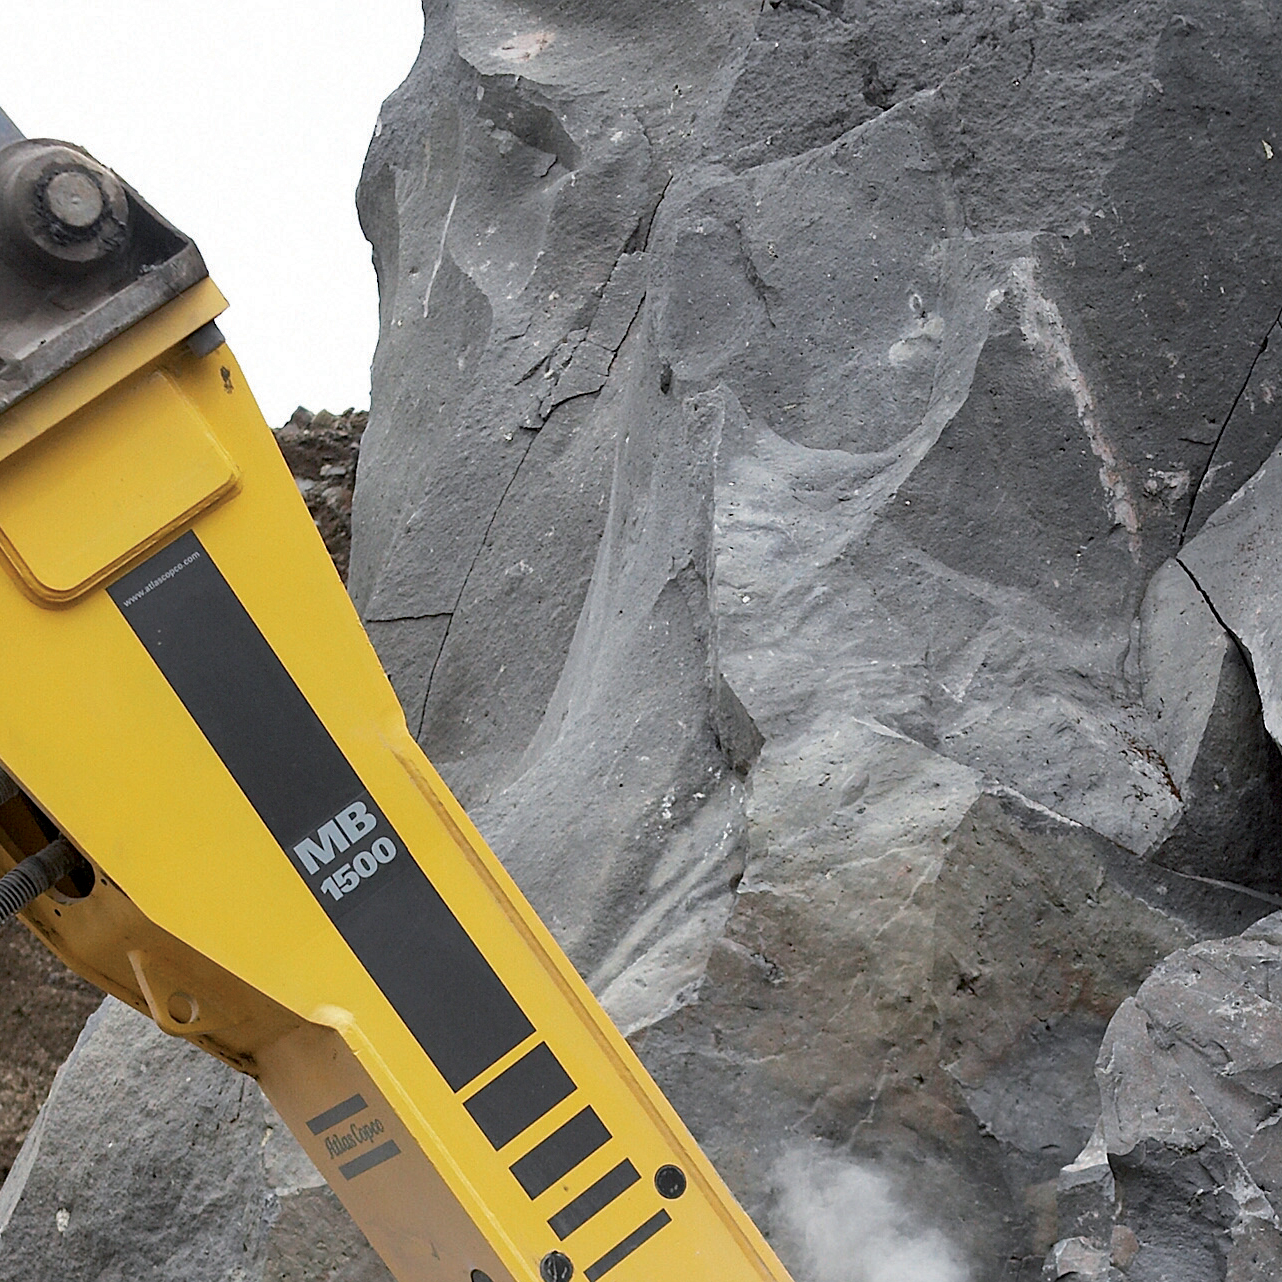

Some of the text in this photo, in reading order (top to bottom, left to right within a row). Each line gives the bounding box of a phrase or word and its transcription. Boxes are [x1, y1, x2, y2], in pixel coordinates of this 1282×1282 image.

[123, 551, 201, 607] www.atlascopco.com
[293, 801, 377, 875] MB
[320, 836, 397, 901] 1500
[325, 1118, 384, 1160] Atlas Copco
